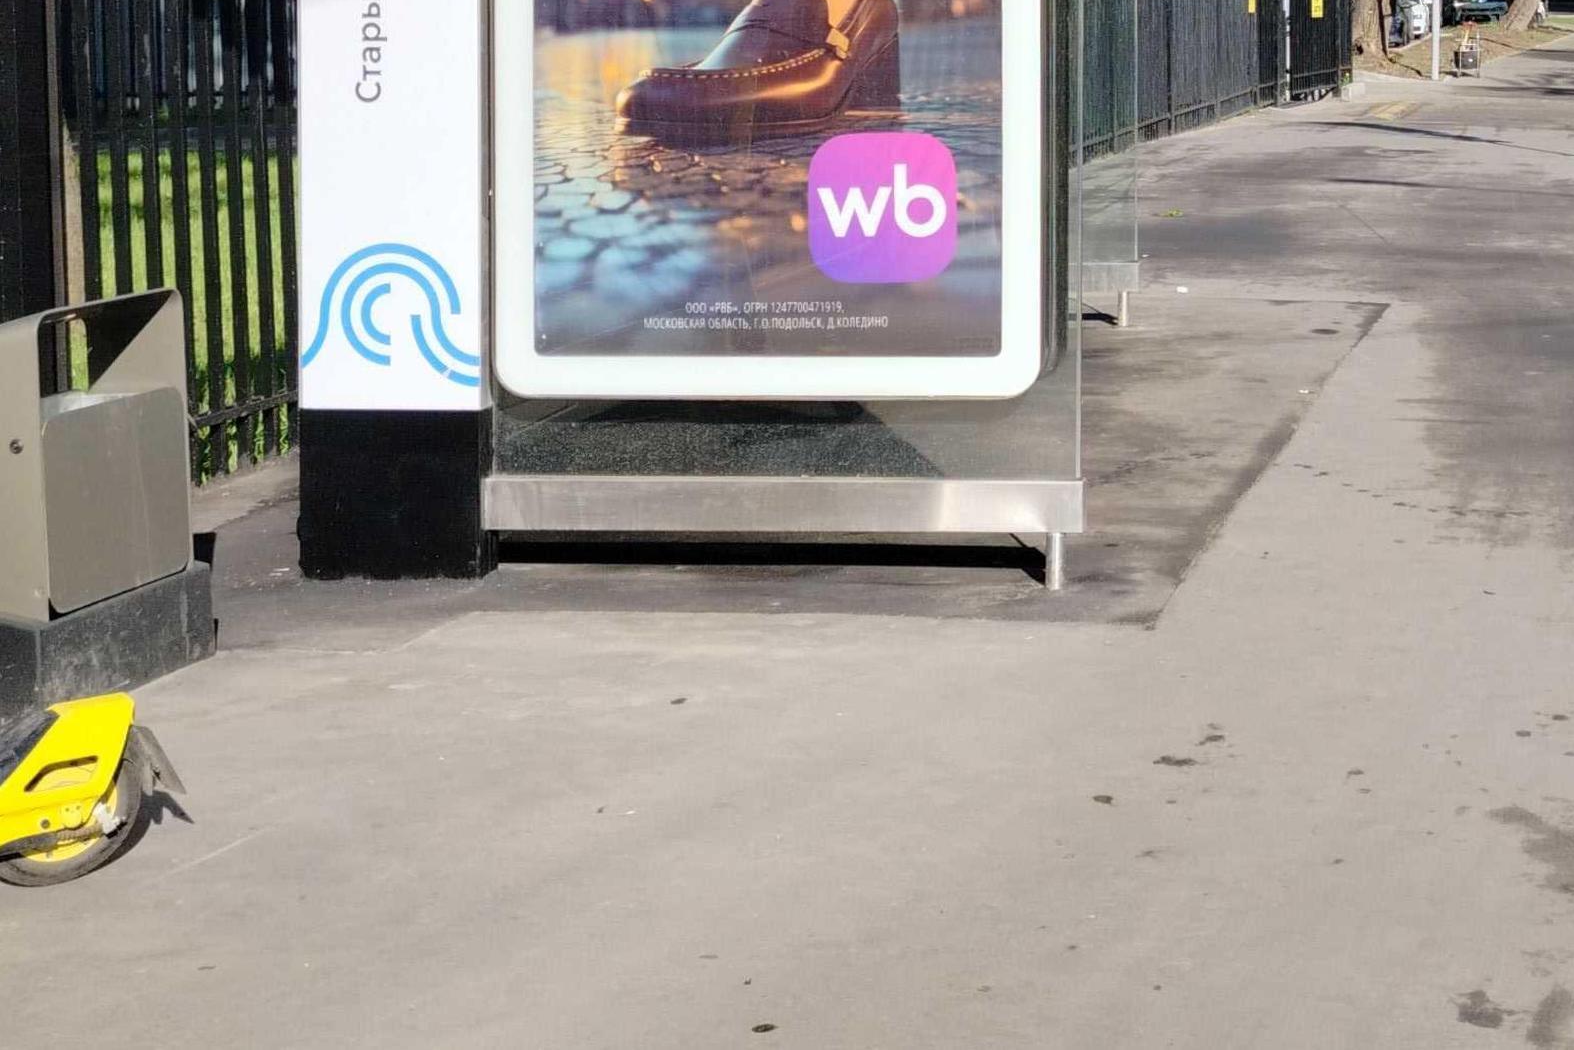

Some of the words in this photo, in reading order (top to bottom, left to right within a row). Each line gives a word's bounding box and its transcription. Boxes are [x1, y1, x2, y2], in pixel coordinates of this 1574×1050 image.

[816, 163, 947, 238] wb
[685, 302, 707, 314] ООО
[743, 302, 768, 314] ОГРН
[643, 317, 706, 329] МОСКОВСКАЯ
[708, 317, 752, 330] ОБЛАСТЬ,
